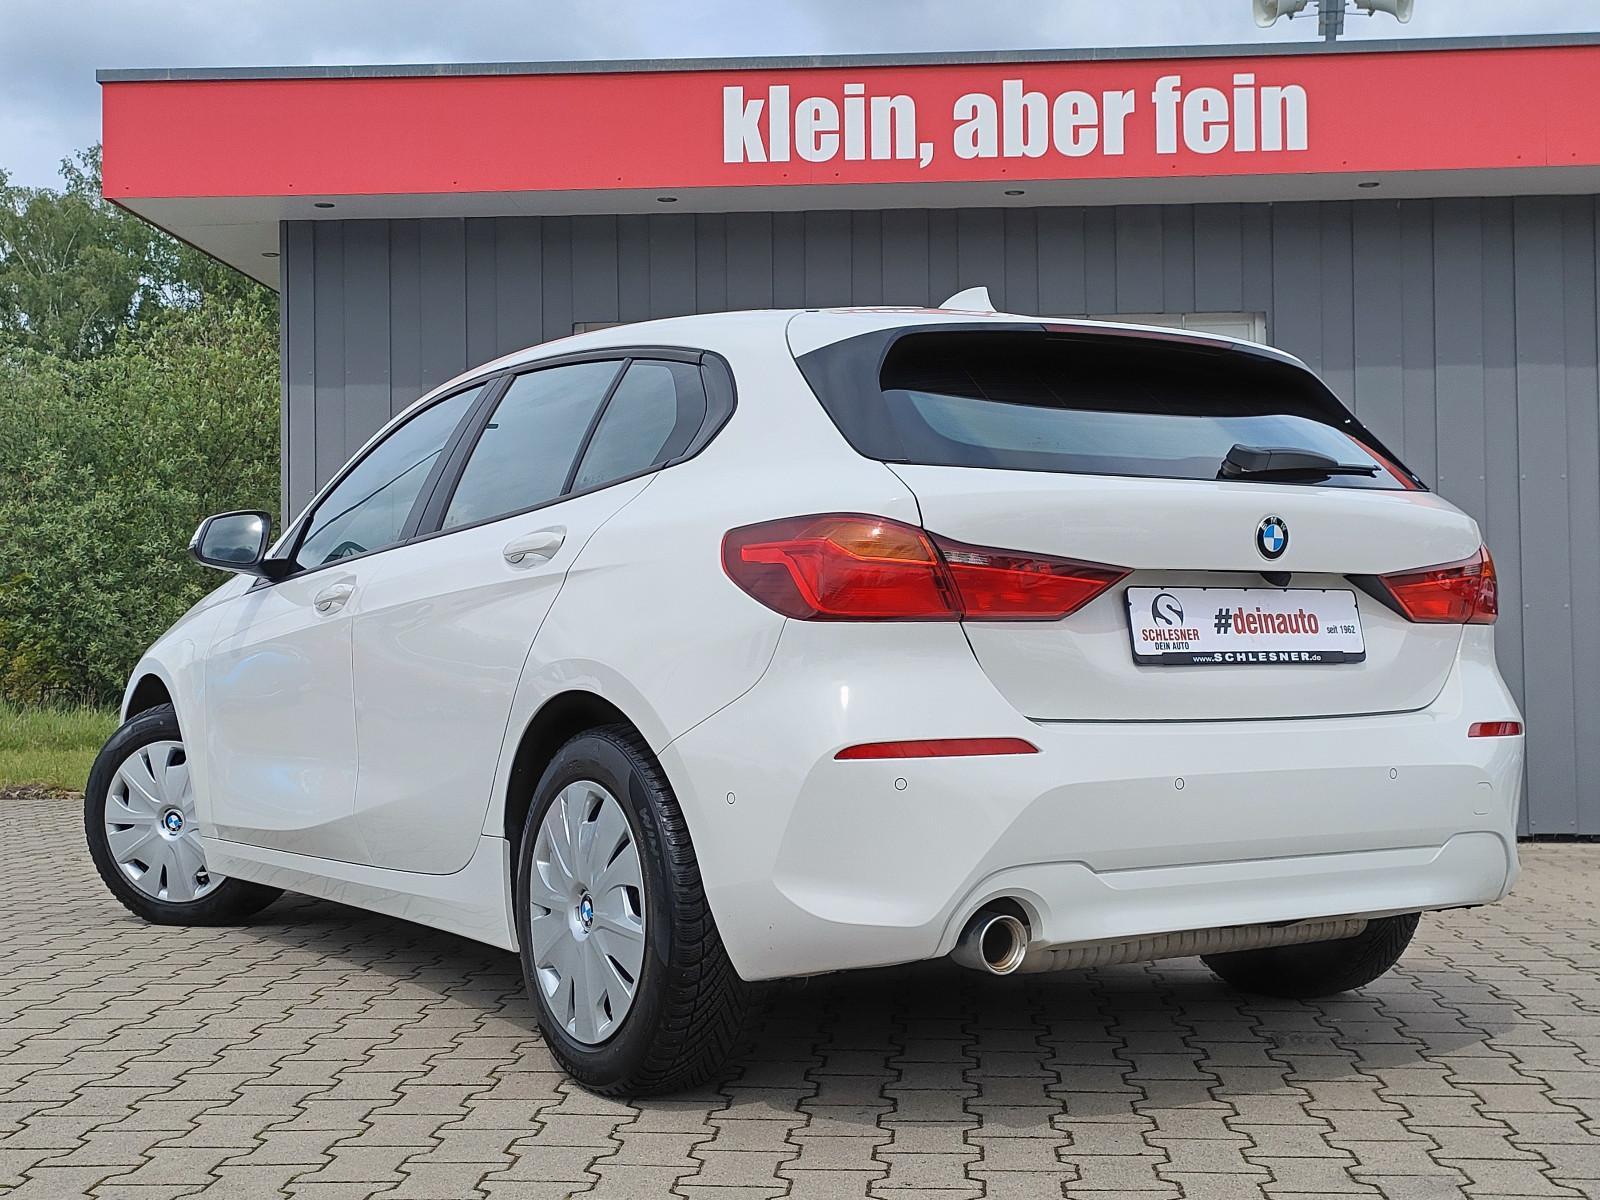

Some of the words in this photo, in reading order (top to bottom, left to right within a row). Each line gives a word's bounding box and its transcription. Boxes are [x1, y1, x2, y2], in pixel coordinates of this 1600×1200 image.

[723, 83, 934, 168] klein,
[953, 79, 1135, 158] aber
[1152, 73, 1308, 154] fein
[1213, 607, 1320, 635] #deinauto
[1142, 629, 1200, 641] SCHLESNER
[1326, 625, 1339, 634] seit
[1340, 625, 1356, 634] 1962
[1155, 642, 1171, 650] DEIN
[1172, 642, 1190, 650] AUTO
[1192, 652, 1322, 663] www.SCHLESNER.de
